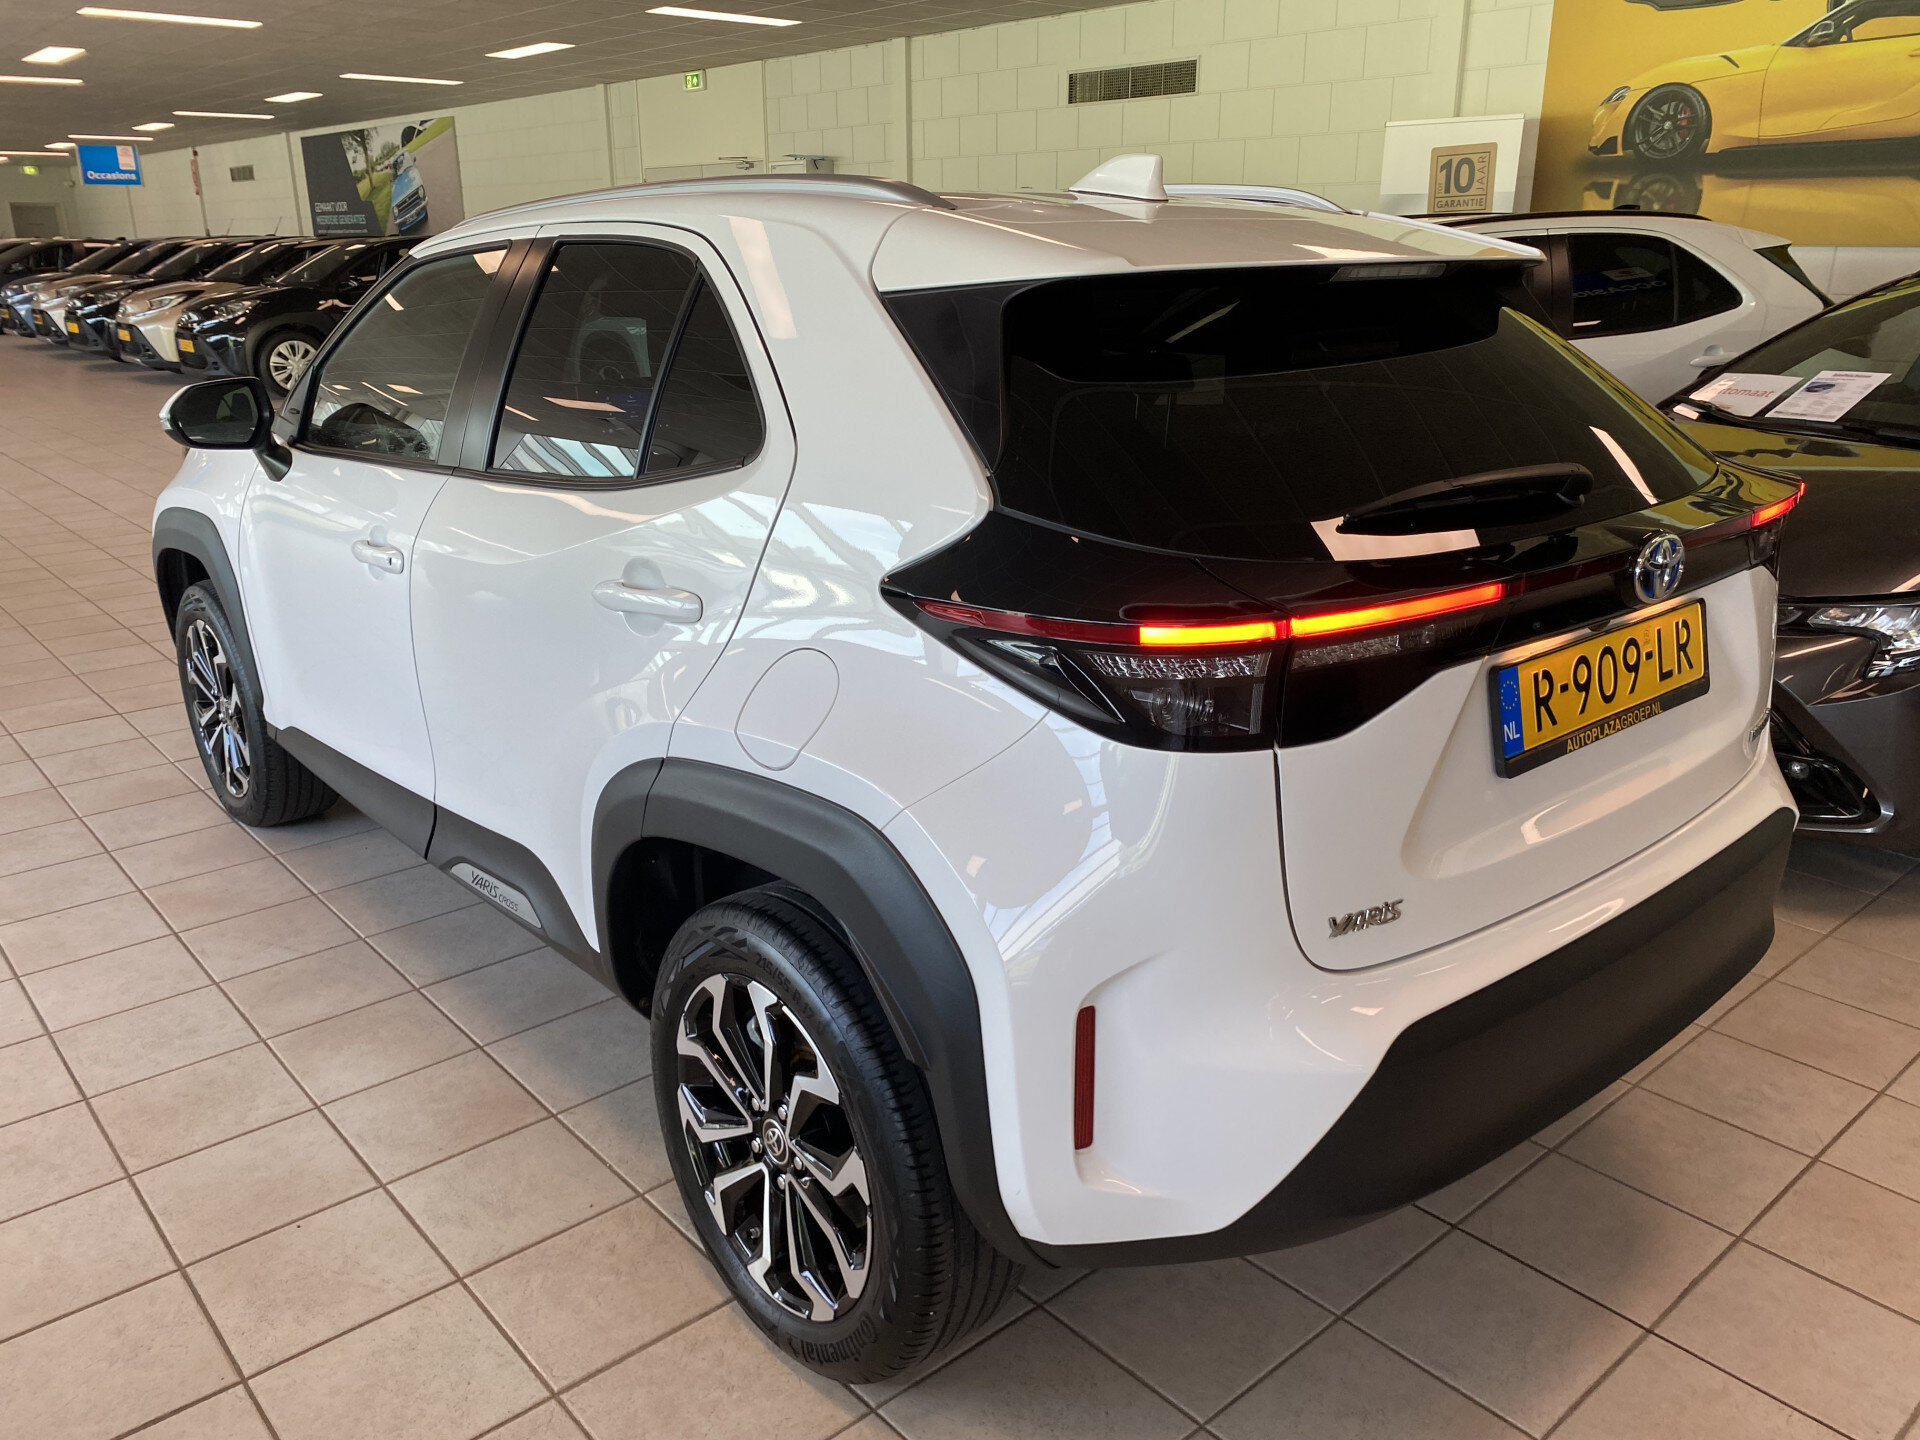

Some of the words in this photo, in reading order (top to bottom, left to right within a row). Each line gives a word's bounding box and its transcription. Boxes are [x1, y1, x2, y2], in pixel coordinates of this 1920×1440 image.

[87, 170, 137, 180] Occasions
[1439, 157, 1475, 194] 10
[1476, 155, 1488, 192] JAAR
[1436, 198, 1485, 209] GARANTIE
[1532, 618, 1694, 733] R-909-LR
[1504, 721, 1520, 743] NL
[1566, 702, 1663, 754] AUTOPLAZAGROEP.NL
[499, 894, 518, 912] CROSS
[800, 1310, 879, 1367] Continental
